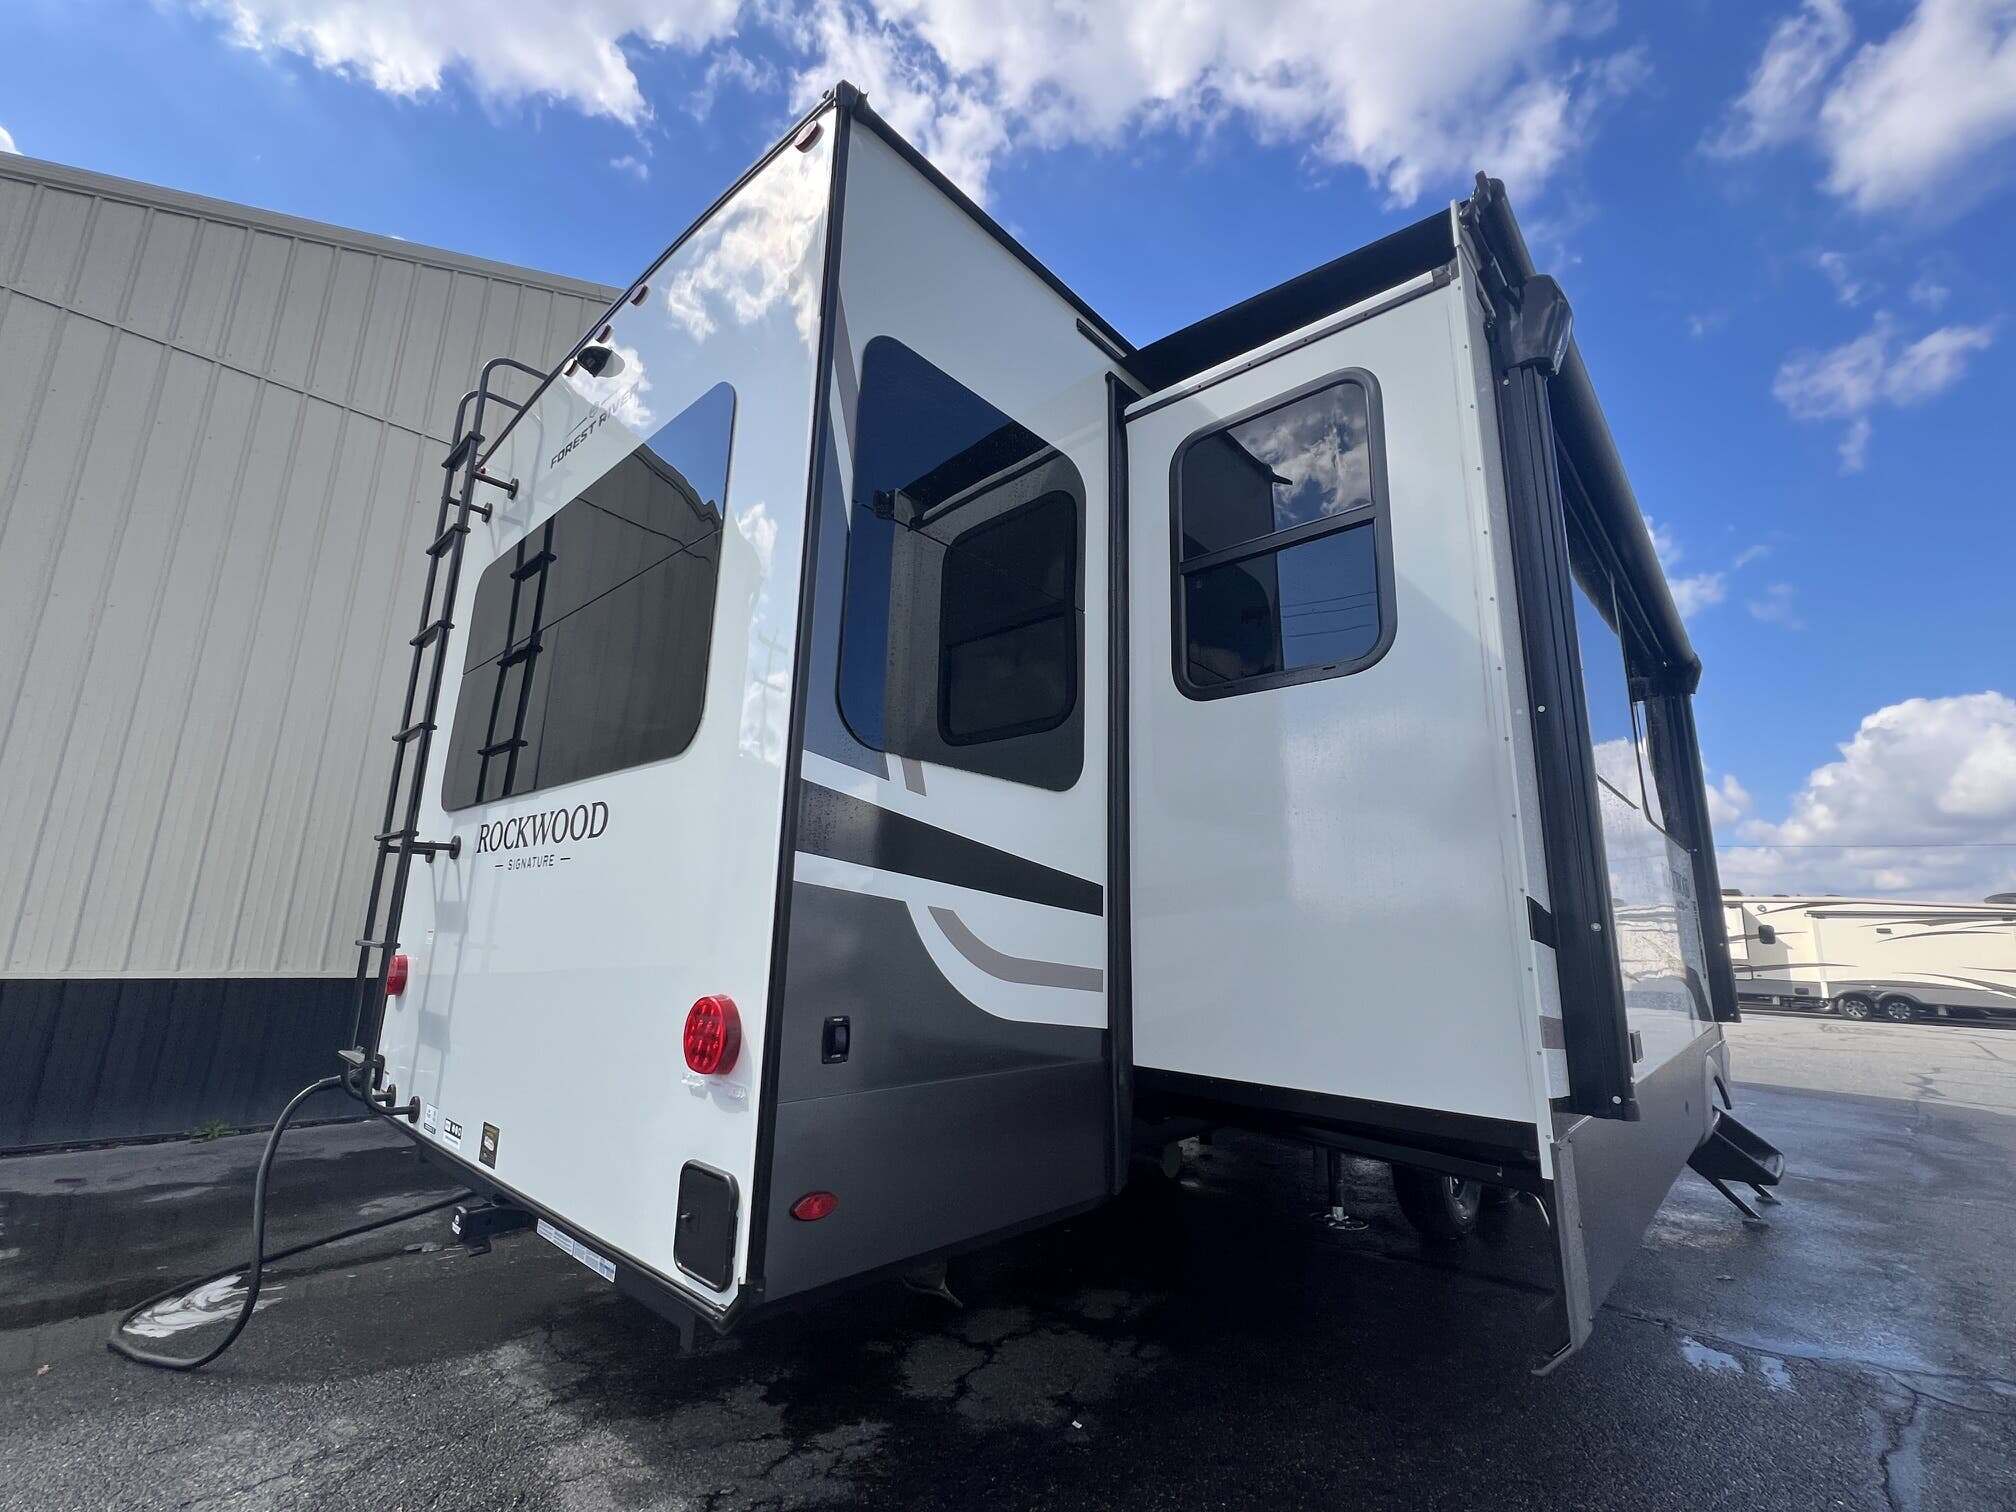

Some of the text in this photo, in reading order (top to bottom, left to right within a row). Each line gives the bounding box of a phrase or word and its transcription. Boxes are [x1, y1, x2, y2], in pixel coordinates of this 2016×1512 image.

[550, 420, 597, 469] FOREST
[476, 801, 609, 853] ROCKWOOD
[508, 854, 555, 871] SIGNATURE
